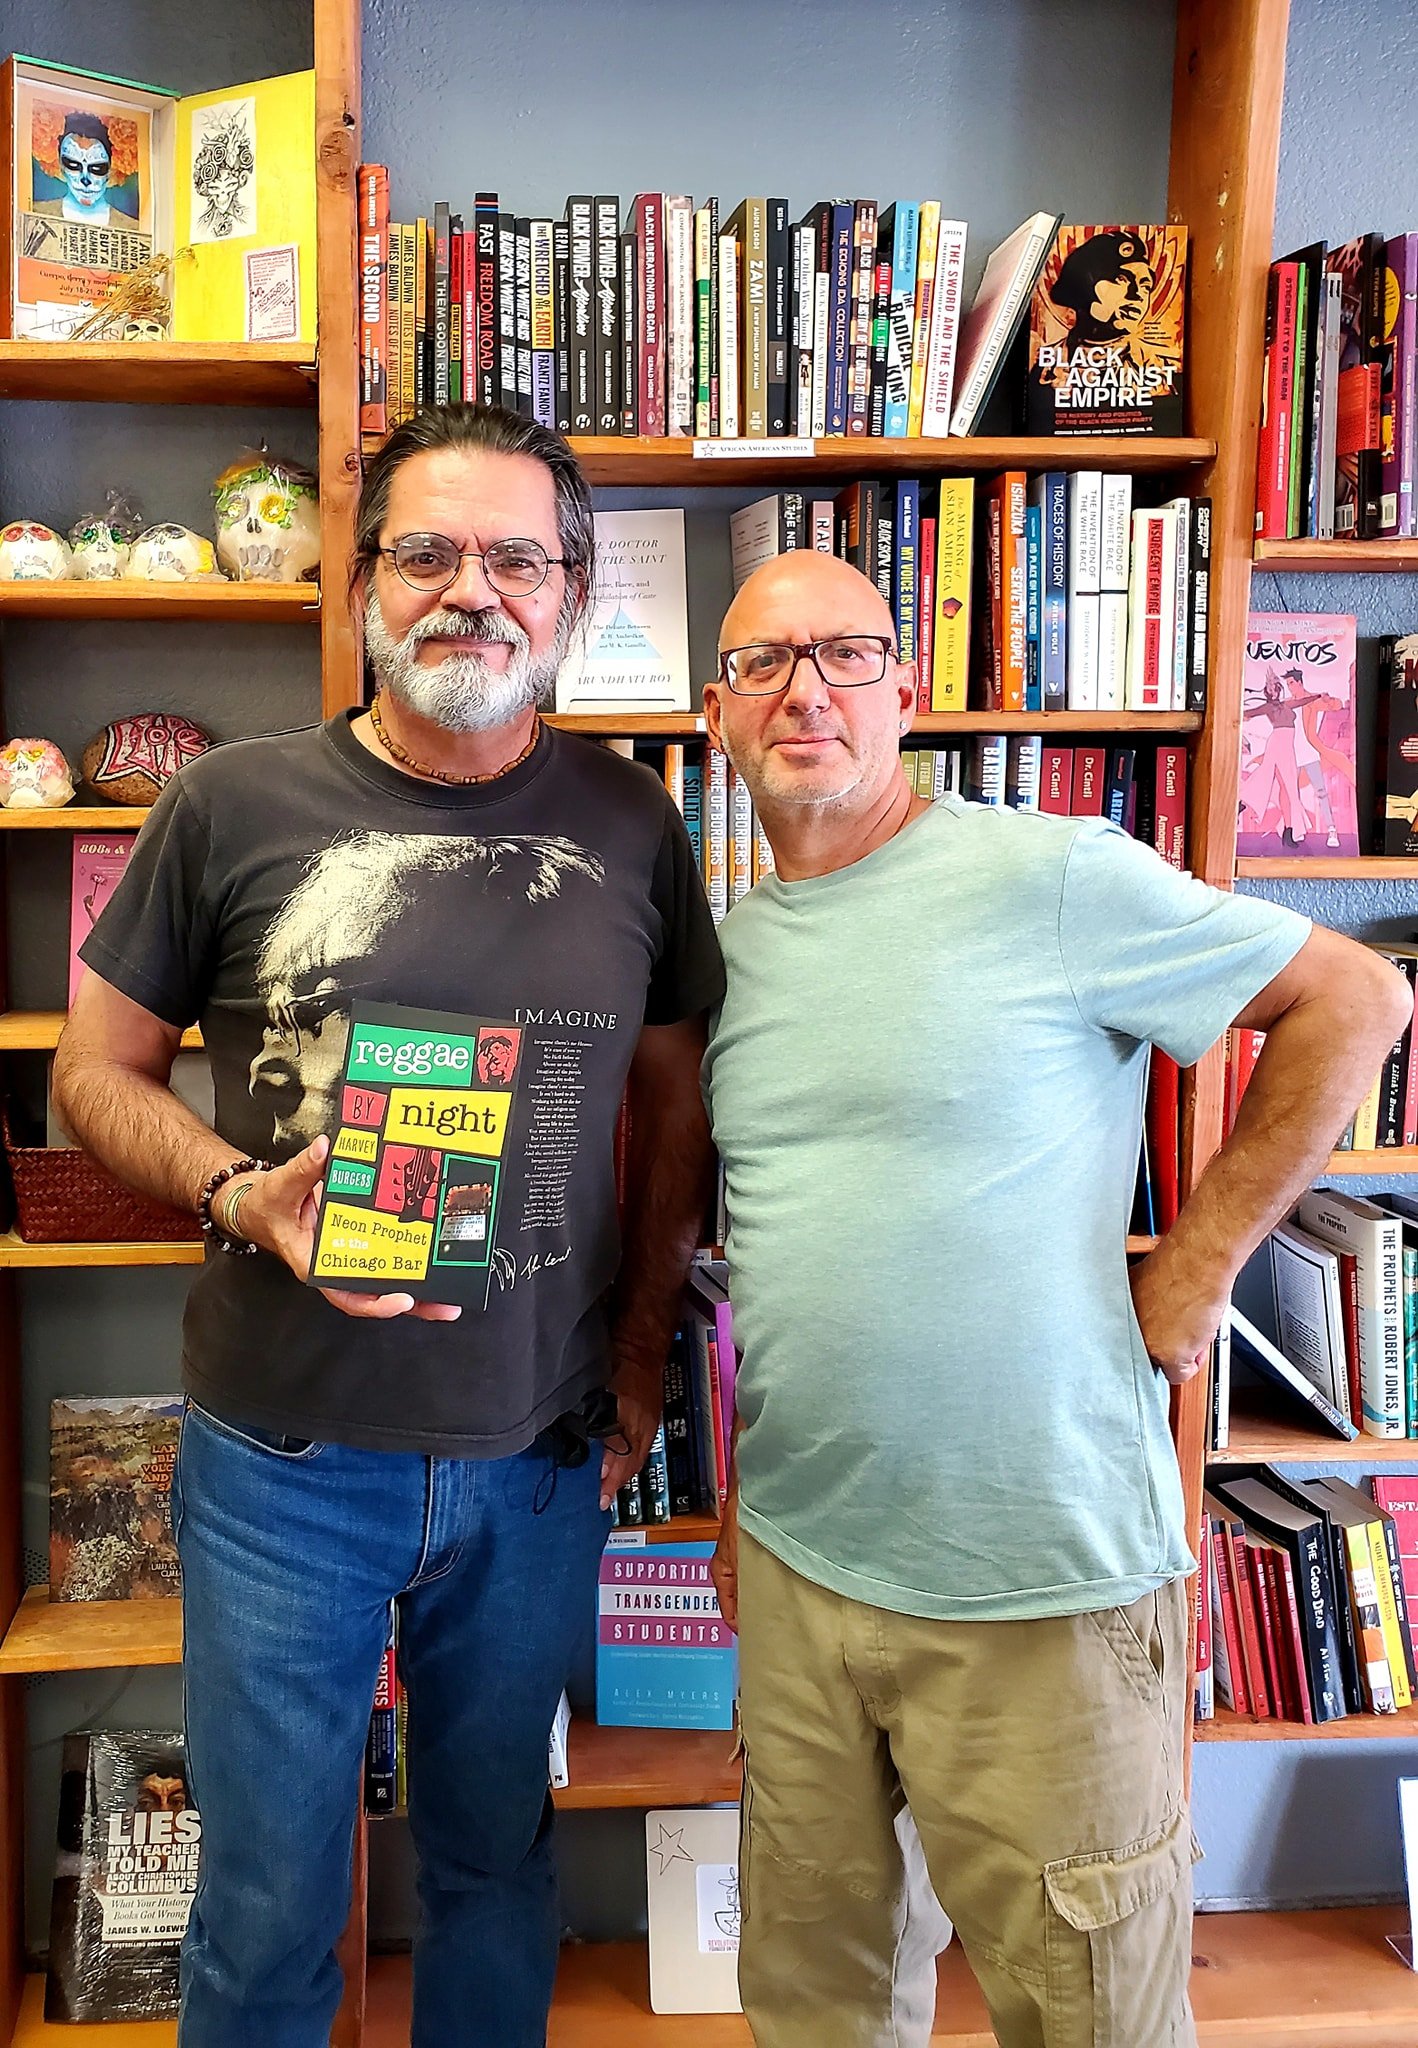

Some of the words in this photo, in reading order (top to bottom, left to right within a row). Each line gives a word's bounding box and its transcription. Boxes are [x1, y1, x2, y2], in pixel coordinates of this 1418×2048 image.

[573, 204, 590, 237] BLACK
[599, 204, 616, 237] BLACK
[645, 205, 656, 236] BLACK
[100, 233, 109, 256] BUT
[363, 234, 381, 261] THE
[388, 233, 399, 260] JAMES
[403, 235, 414, 262] JAMES
[479, 224, 494, 255] FAST
[555, 228, 568, 259] REPAIR
[839, 229, 848, 245] THE
[534, 238, 551, 296] WRETCHED
[573, 239, 590, 278] POWER
[599, 239, 616, 278] POWER
[837, 248, 848, 286] ECHOING
[949, 243, 961, 266] THE
[388, 263, 399, 302] BALDWIN
[403, 265, 414, 303] BALDWIN
[749, 260, 763, 304] ZAMI
[801, 255, 812, 284] Other
[59, 284, 75, 294] July
[97, 290, 114, 298] 2012
[363, 263, 381, 323] SECOND
[436, 279, 447, 319] THEM
[479, 262, 494, 326] FREEDOM
[517, 288, 531, 317] WHITE
[902, 291, 914, 309] THE
[944, 270, 958, 311] SWORD
[388, 309, 399, 334] NOTES
[534, 311, 551, 346] EARTH
[645, 313, 656, 344] SCARE
[800, 312, 810, 345] Moore
[835, 308, 846, 361] COLLECTION
[943, 316, 955, 340] AND
[436, 322, 447, 358] GOON
[479, 330, 494, 370] ROAD
[889, 303, 912, 372] RADICAL
[538, 354, 551, 385] FRANTZ
[646, 355, 654, 377] GERALD
[940, 345, 952, 366] THE
[1038, 346, 1124, 367] BLACK
[1281, 355, 1290, 375] THE
[388, 356, 399, 390] NATIVE
[403, 361, 414, 393] NATIVE
[887, 365, 907, 404] KING
[1065, 366, 1178, 387] AGAINST
[1370, 367, 1378, 398] THE
[538, 387, 551, 416] FANON
[935, 371, 950, 413] SHIELD
[1054, 387, 1153, 407] EMPIRE
[1369, 400, 1377, 446] SYSTEM
[719, 443, 747, 453] AFRICAN
[748, 443, 779, 453] AMERICAN
[946, 487, 955, 526] ASIAN
[1010, 483, 1024, 535] ISHIZUKA
[1052, 484, 1064, 525] TRACES
[1080, 494, 1088, 513] THE
[1107, 493, 1115, 512] THE
[1117, 488, 1125, 507] THE
[786, 505, 796, 528] THE
[1079, 515, 1087, 546] WHITE
[1106, 514, 1115, 546] WHITE
[608, 539, 659, 549] DOCTOR
[877, 519, 891, 544] BLACK
[1052, 526, 1064, 541] OF
[1089, 509, 1097, 562] INVENTION
[1116, 509, 1125, 563] INVENTION
[1149, 519, 1163, 573] INSURGENT
[601, 555, 627, 565] THE
[629, 553, 668, 564] SAINT
[899, 546, 913, 562] MY
[943, 530, 953, 592] AMERICA
[1052, 543, 1064, 587] HISTORY
[1079, 548, 1087, 573] RACE
[1106, 547, 1114, 572] RACE
[899, 563, 913, 593] VOICE
[1010, 567, 1023, 603] SERVE
[1196, 571, 1208, 612] SEPARATE
[1148, 577, 1161, 615] EMPIRE
[899, 606, 913, 622] MY
[1051, 601, 1059, 630] PATRICK
[1195, 613, 1207, 632] AND
[899, 624, 913, 664] WEAPON
[1010, 628, 1023, 668] PEOPLE
[577, 675, 646, 686] ARUNDHATI
[649, 674, 672, 683] ROY
[711, 749, 723, 793] EMPIRE
[920, 762, 928, 784] OTERO
[1050, 756, 1061, 770] Dr.
[1083, 756, 1094, 770] Dr.
[1166, 754, 1177, 768] Dr.
[1050, 771, 1061, 798] Cintli
[1083, 771, 1094, 798] Cintli
[1165, 769, 1176, 797] Cintli
[711, 795, 723, 808] OF
[735, 795, 747, 808] OF
[79, 843, 112, 855] 808s
[114, 844, 126, 855] &
[711, 813, 723, 866] BORDERS
[735, 813, 747, 866] BORDERS
[1171, 825, 1184, 859] Writing
[710, 873, 723, 903] TODD
[514, 1008, 618, 1031] IMAGINE
[355, 1039, 470, 1075] reggae
[1389, 1063, 1400, 1095] Lilith's
[353, 1094, 374, 1121] BY
[399, 1100, 497, 1136] night
[1388, 1097, 1397, 1123] Brood
[337, 1136, 376, 1155] HARVEY
[331, 1168, 372, 1189] BURGESS
[330, 1213, 368, 1234] Neon
[370, 1221, 429, 1247] Prophet
[1383, 1228, 1396, 1250] THE
[321, 1253, 387, 1272] Chicago
[392, 1256, 423, 1271] Bar
[1383, 1255, 1397, 1315] PROPHETS
[1384, 1325, 1398, 1370] ROBERT
[1382, 1373, 1399, 1413] JONES,
[1384, 1416, 1399, 1434] JR.
[143, 1473, 169, 1483] AND
[648, 1468, 656, 1490] ELER
[656, 1463, 664, 1493] ALICIA
[1306, 1538, 1318, 1562] THE
[614, 1561, 708, 1581] SUPPORTIN
[1309, 1565, 1322, 1598] GOOD
[614, 1592, 719, 1611] TRANSGENDER
[1312, 1600, 1325, 1629] DEAD
[613, 1623, 720, 1642] STUDENTS
[667, 1690, 719, 1701] MYERS
[108, 1810, 202, 1845] LIES
[107, 1845, 131, 1857] MY
[135, 1842, 200, 1857] TEACHER
[107, 1856, 161, 1873] TOLD
[167, 1854, 199, 1871] ME
[105, 1878, 197, 1894] COLUMBUS
[107, 1873, 137, 1881] ABOUT
[138, 1871, 198, 1880] CHRISTOPHER
[110, 1899, 134, 1909] What
[135, 1898, 157, 1908] Your
[157, 1897, 190, 1909] History
[113, 1910, 138, 1920] Books
[140, 1909, 156, 1919] Got
[158, 1908, 186, 1920] Wrong
